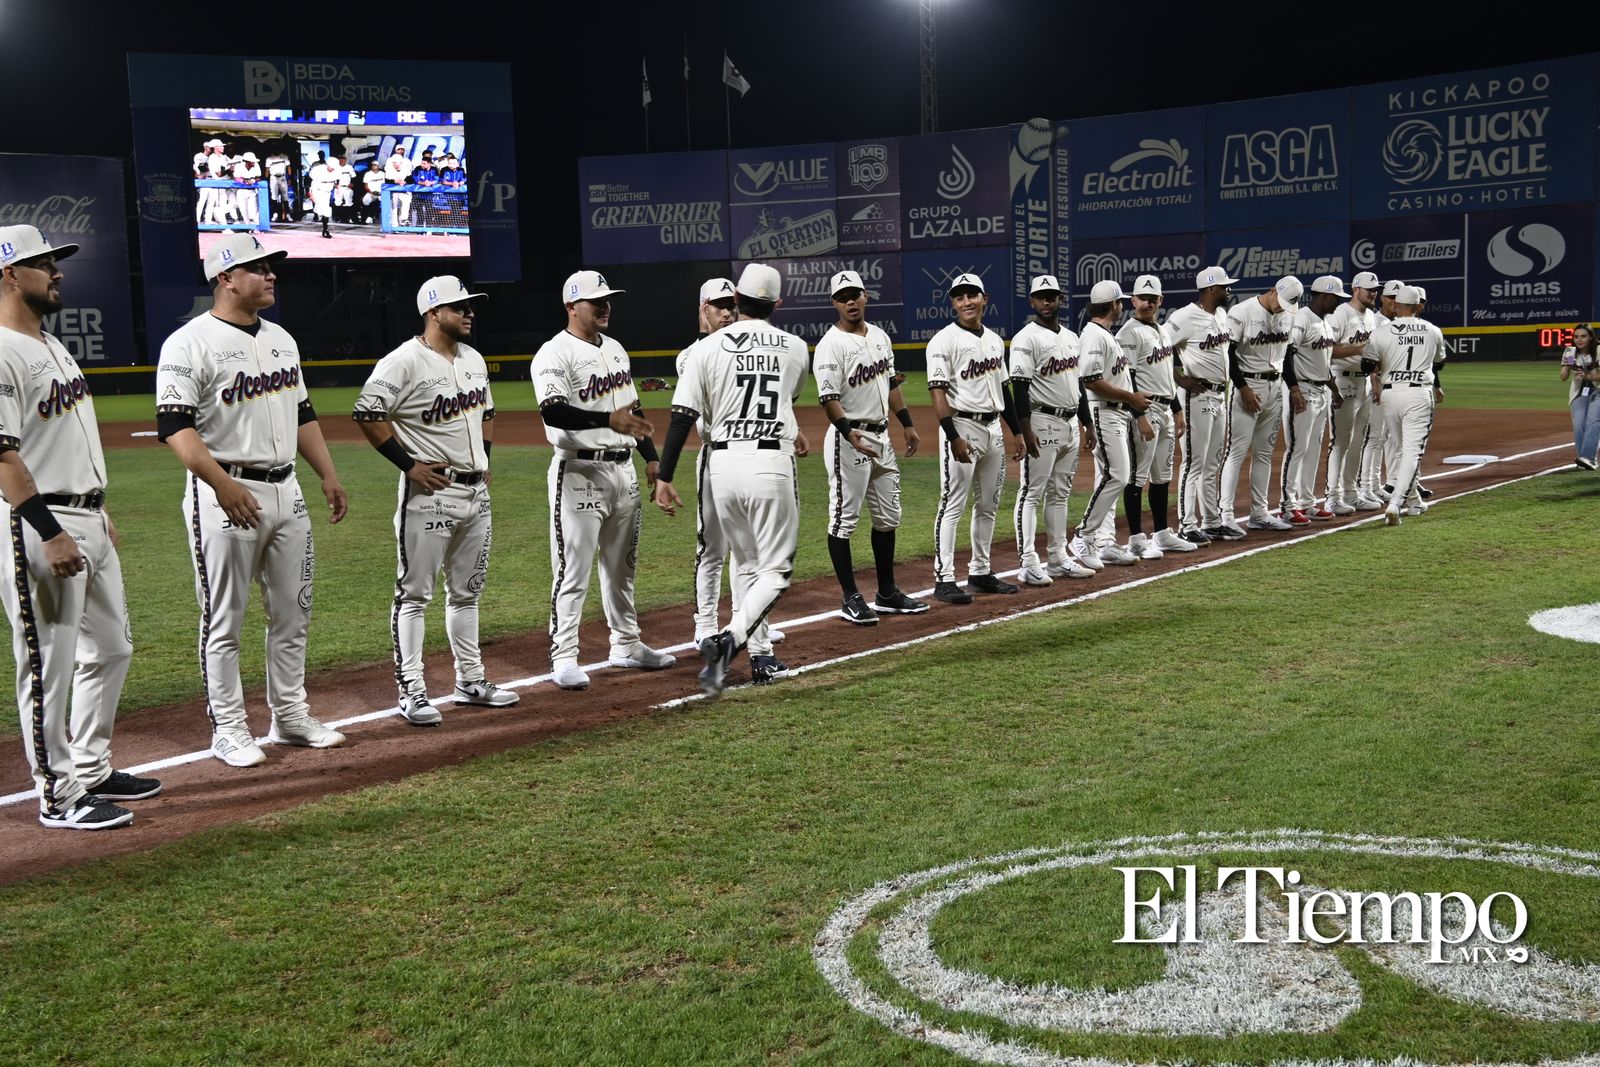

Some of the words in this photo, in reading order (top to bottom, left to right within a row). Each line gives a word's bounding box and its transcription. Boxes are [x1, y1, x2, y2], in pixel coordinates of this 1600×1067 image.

[294, 63, 355, 80] BEDA
[295, 84, 412, 102] INDUSTRIAS
[1388, 73, 1550, 111] KICKAPOO
[1448, 106, 1550, 147] LUCKY
[850, 145, 887, 162] LMB
[1448, 142, 1549, 181] EAGLE
[735, 157, 829, 192] VALUE
[1057, 149, 1069, 219] RESULTADO
[1082, 165, 1193, 195] Electrolit
[607, 184, 631, 193] Better
[608, 192, 650, 202] TOGETHER
[1220, 188, 1247, 200] CORTES
[1249, 188, 1256, 197] Y
[1256, 185, 1294, 196] SERVICIOS
[1312, 182, 1323, 192] de
[1387, 192, 1463, 211] CASINO
[1481, 185, 1548, 203] HOTEL
[0, 194, 97, 235] ca-Cola
[591, 201, 722, 229] GREENBRIER
[909, 205, 961, 220] GRUPO
[1014, 202, 1025, 212] EL
[660, 223, 723, 245] GIMSA
[748, 240, 768, 260] EL
[768, 215, 833, 251] OFERTON
[842, 223, 896, 234] RYMCO
[909, 216, 1006, 239] LAZALDE
[1058, 224, 1069, 241] ES
[776, 248, 790, 257] DE
[793, 231, 836, 250] CARNES
[1384, 245, 1404, 260] GG
[1407, 244, 1457, 259] Trailers
[1015, 221, 1027, 298] IMPULSANDO
[1122, 254, 1201, 273] MIKARO
[1243, 256, 1344, 278] RESEMSA
[838, 274, 852, 285] A
[1490, 280, 1561, 298] simas
[41, 308, 104, 334] WER
[1500, 310, 1524, 321] agua
[1527, 310, 1552, 320] para
[1555, 308, 1580, 317] vivir
[63, 335, 106, 360] DE
[722, 332, 789, 351] VALUE
[1398, 335, 1424, 346] SIMON
[736, 354, 780, 372] SORIA
[1405, 346, 1414, 371] 1
[221, 364, 299, 407] Acerero
[1389, 370, 1425, 382] TECATE
[736, 374, 780, 420] 75
[722, 419, 785, 440] TECATE
[577, 502, 601, 510] JAC
